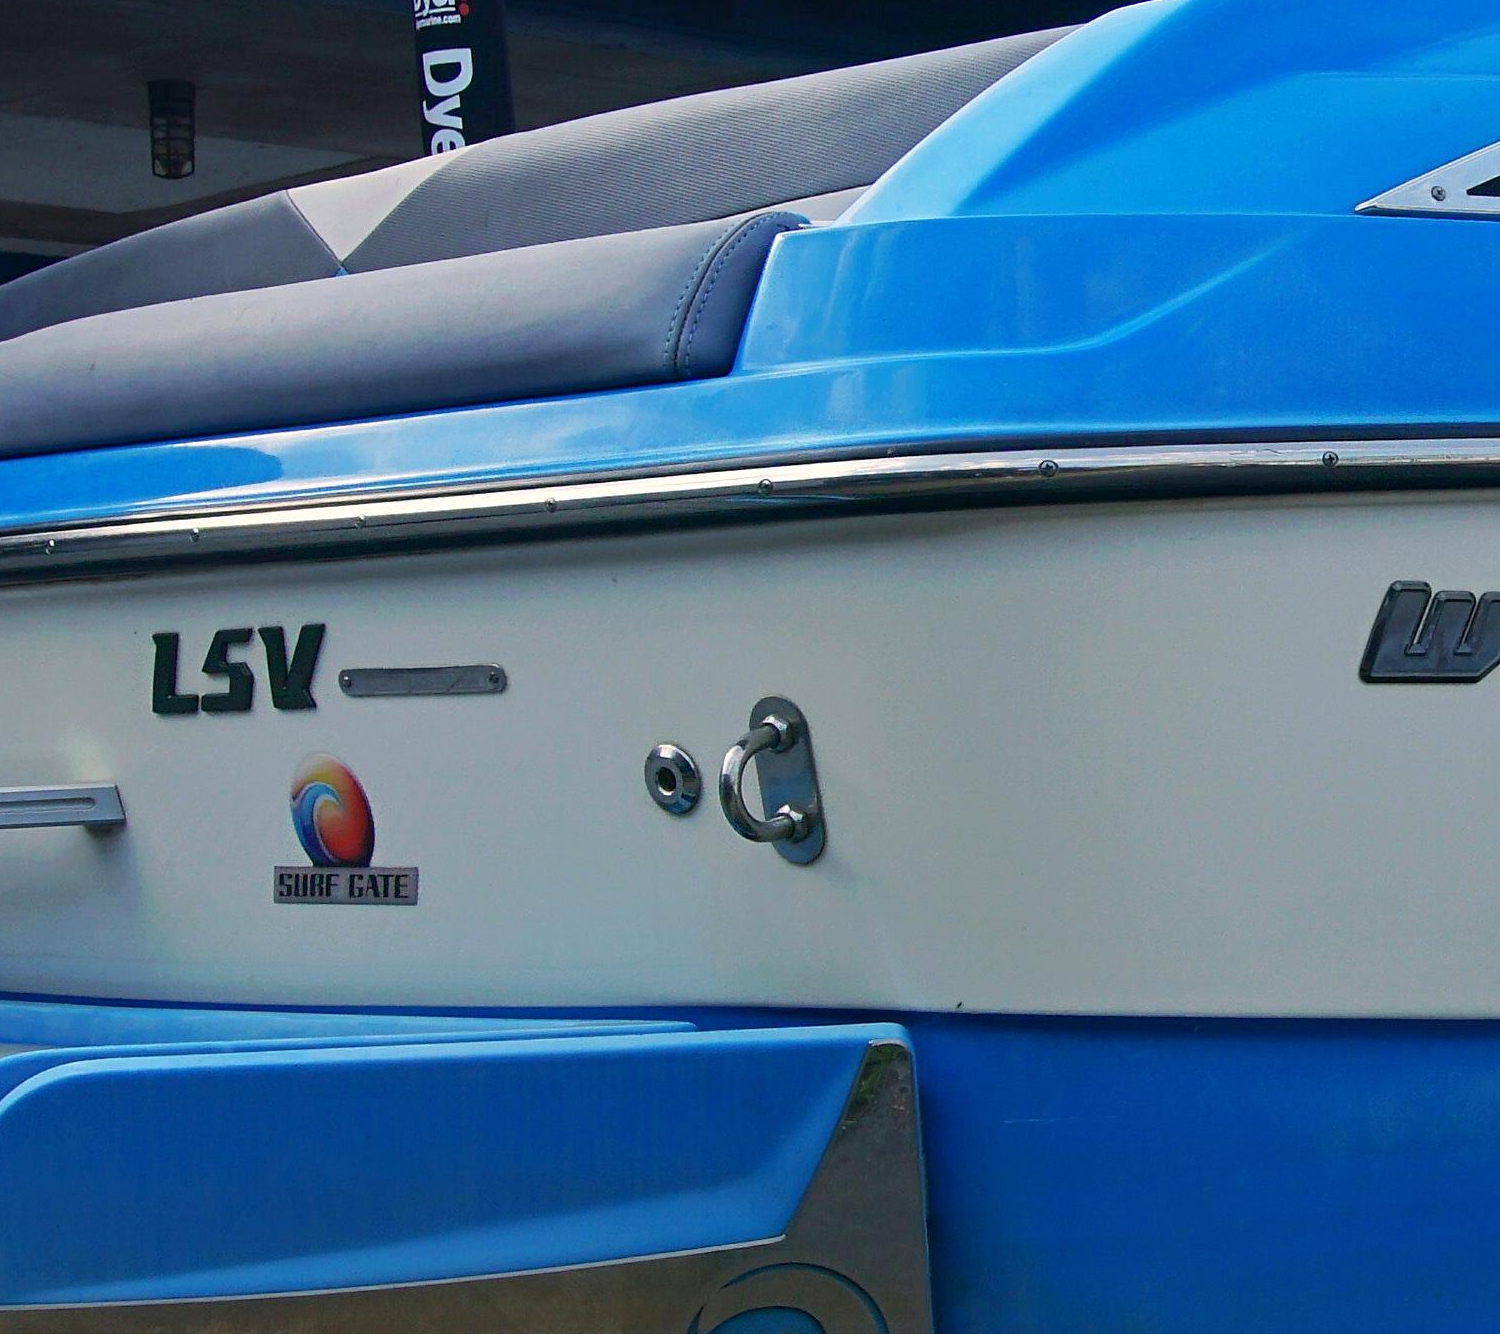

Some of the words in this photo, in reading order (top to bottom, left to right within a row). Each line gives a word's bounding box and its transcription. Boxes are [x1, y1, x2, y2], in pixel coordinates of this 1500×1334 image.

[151, 622, 327, 716] LSV
[278, 873, 340, 899] SURF
[348, 873, 410, 900] GATE
